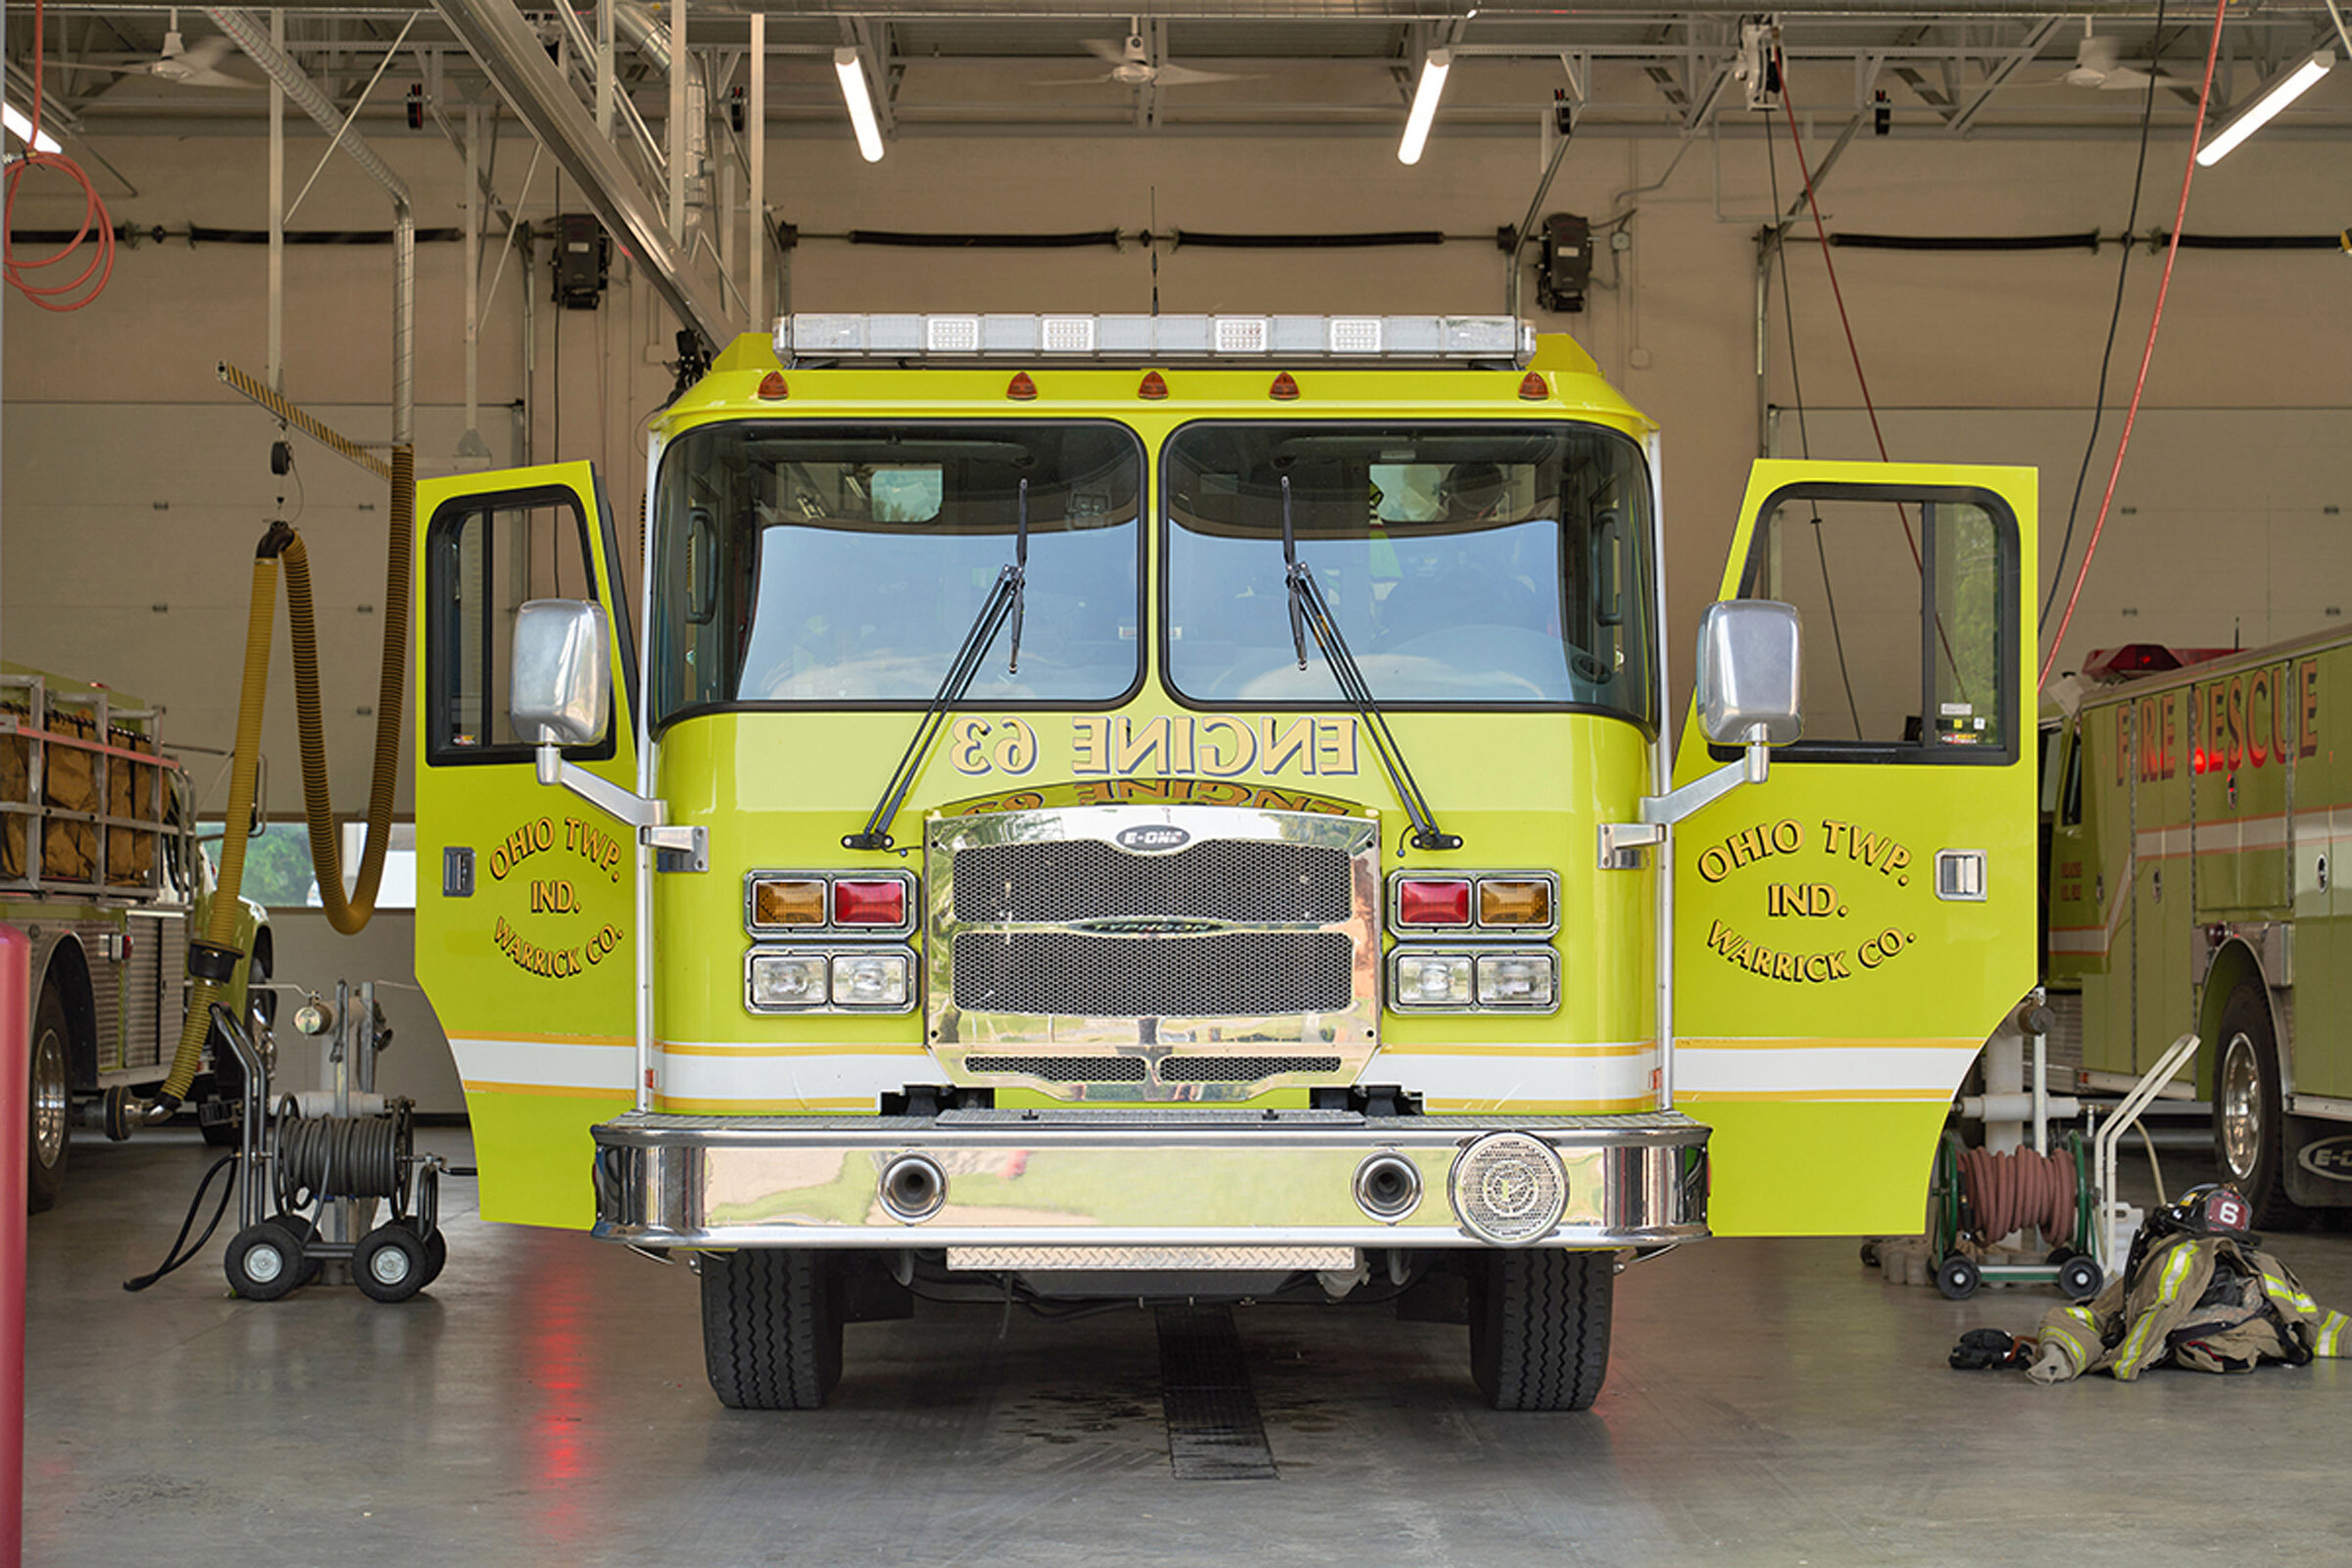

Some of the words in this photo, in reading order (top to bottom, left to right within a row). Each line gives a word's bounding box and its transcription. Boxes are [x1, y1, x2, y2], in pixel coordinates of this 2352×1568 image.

[2116, 693, 2176, 787] FRE
[490, 817, 555, 880] OHIO
[564, 817, 621, 882] TWP.
[1698, 818, 1805, 883] OHIO
[1823, 819, 1912, 886] TWP.
[531, 880, 581, 913] IND.
[1768, 883, 1849, 916] IND.
[494, 916, 582, 978] WARRICK
[586, 924, 623, 964] CO.
[1706, 919, 1851, 982] WARRICK
[1858, 927, 1917, 968] CO.
[2220, 1201, 2239, 1224] 6
